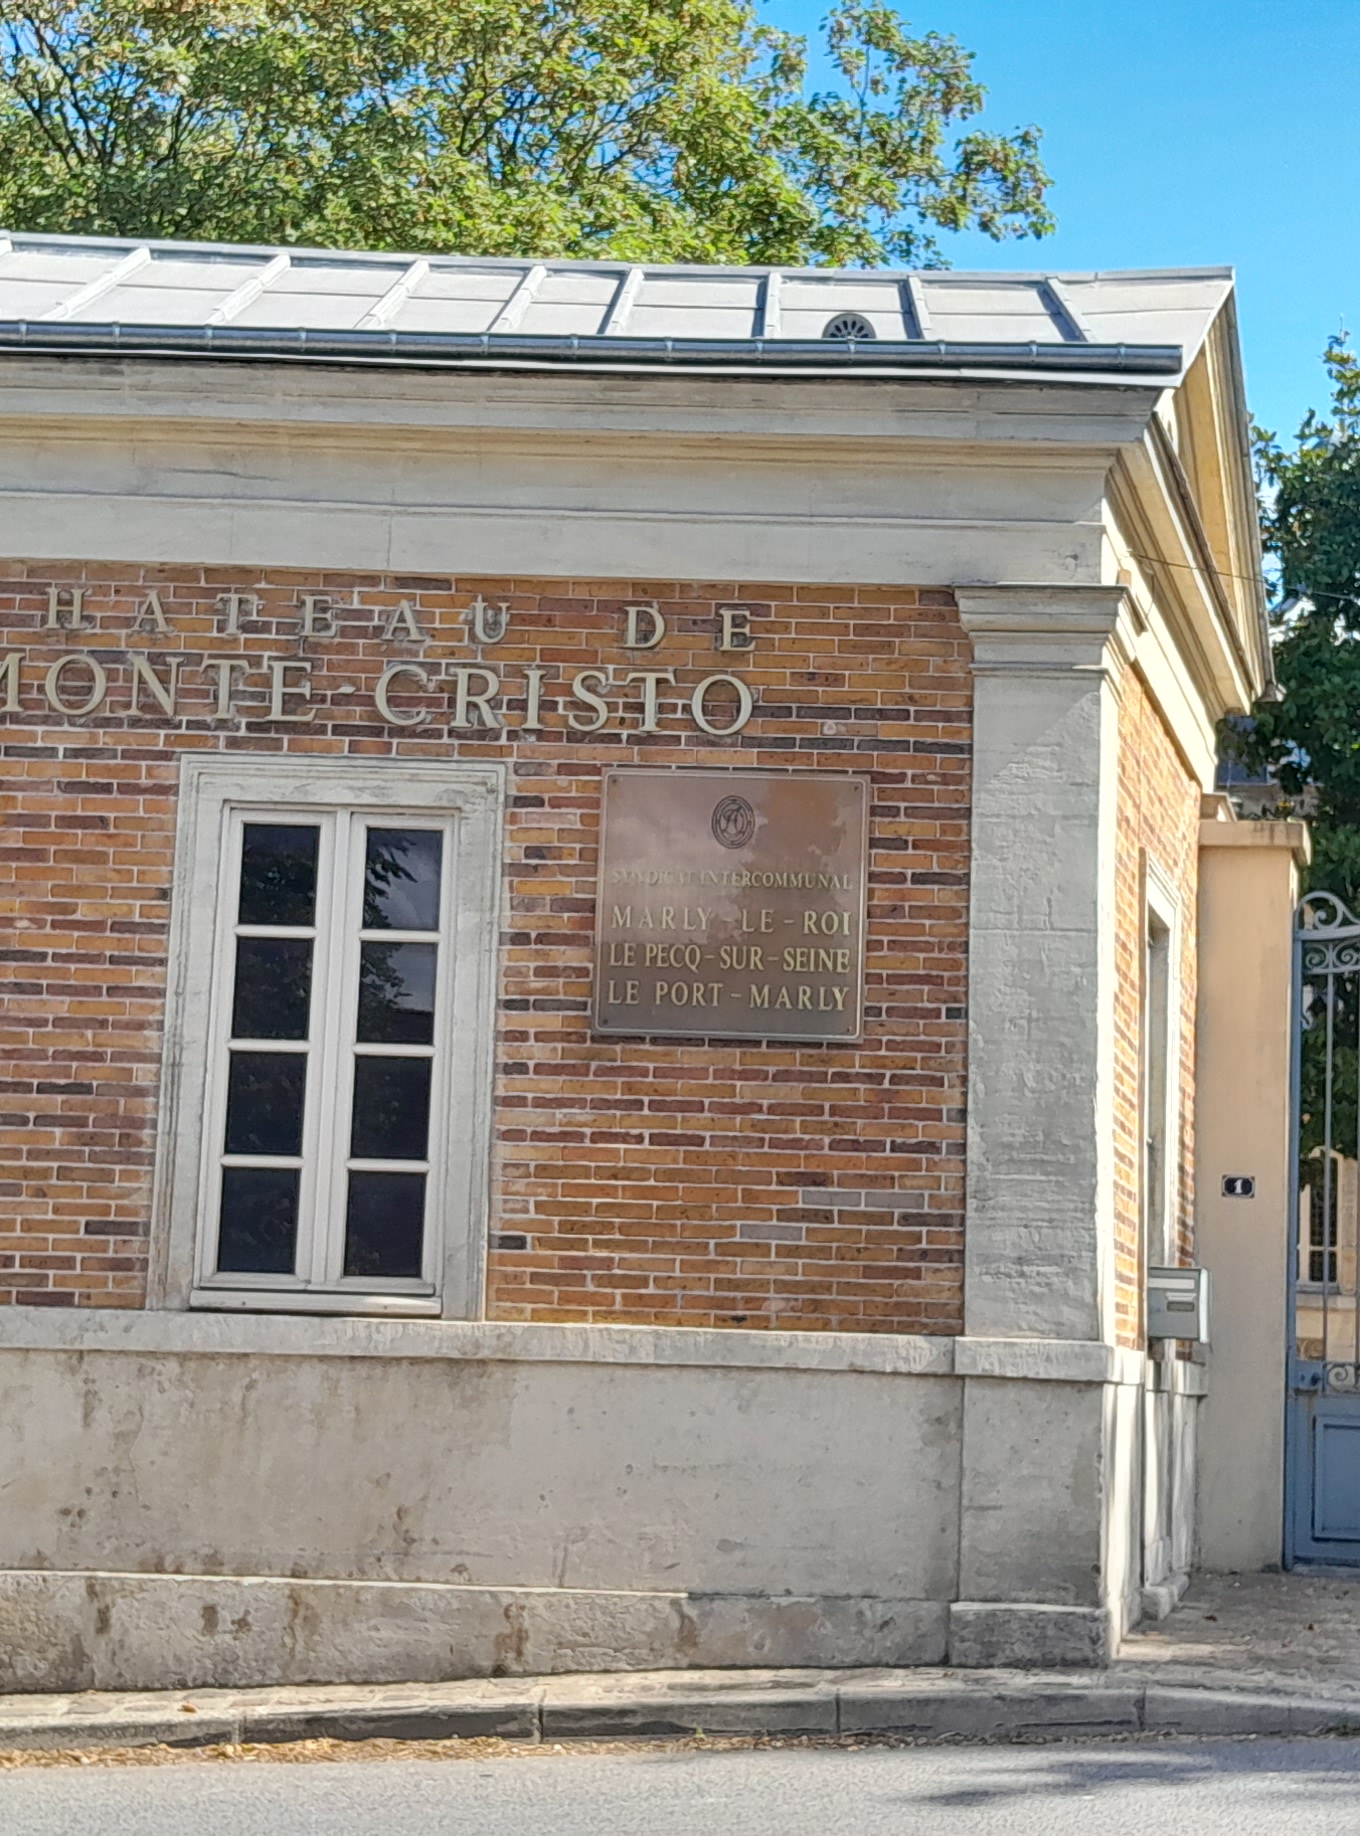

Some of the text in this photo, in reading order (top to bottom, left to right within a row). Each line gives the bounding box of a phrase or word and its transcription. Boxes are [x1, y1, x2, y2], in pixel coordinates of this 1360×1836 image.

[623, 604, 758, 653] DE
[699, 871, 854, 890] INTERCOMMUNAL
[608, 943, 637, 967] LE
[607, 980, 640, 1005] LE
[1233, 1179, 1243, 1194] 1
